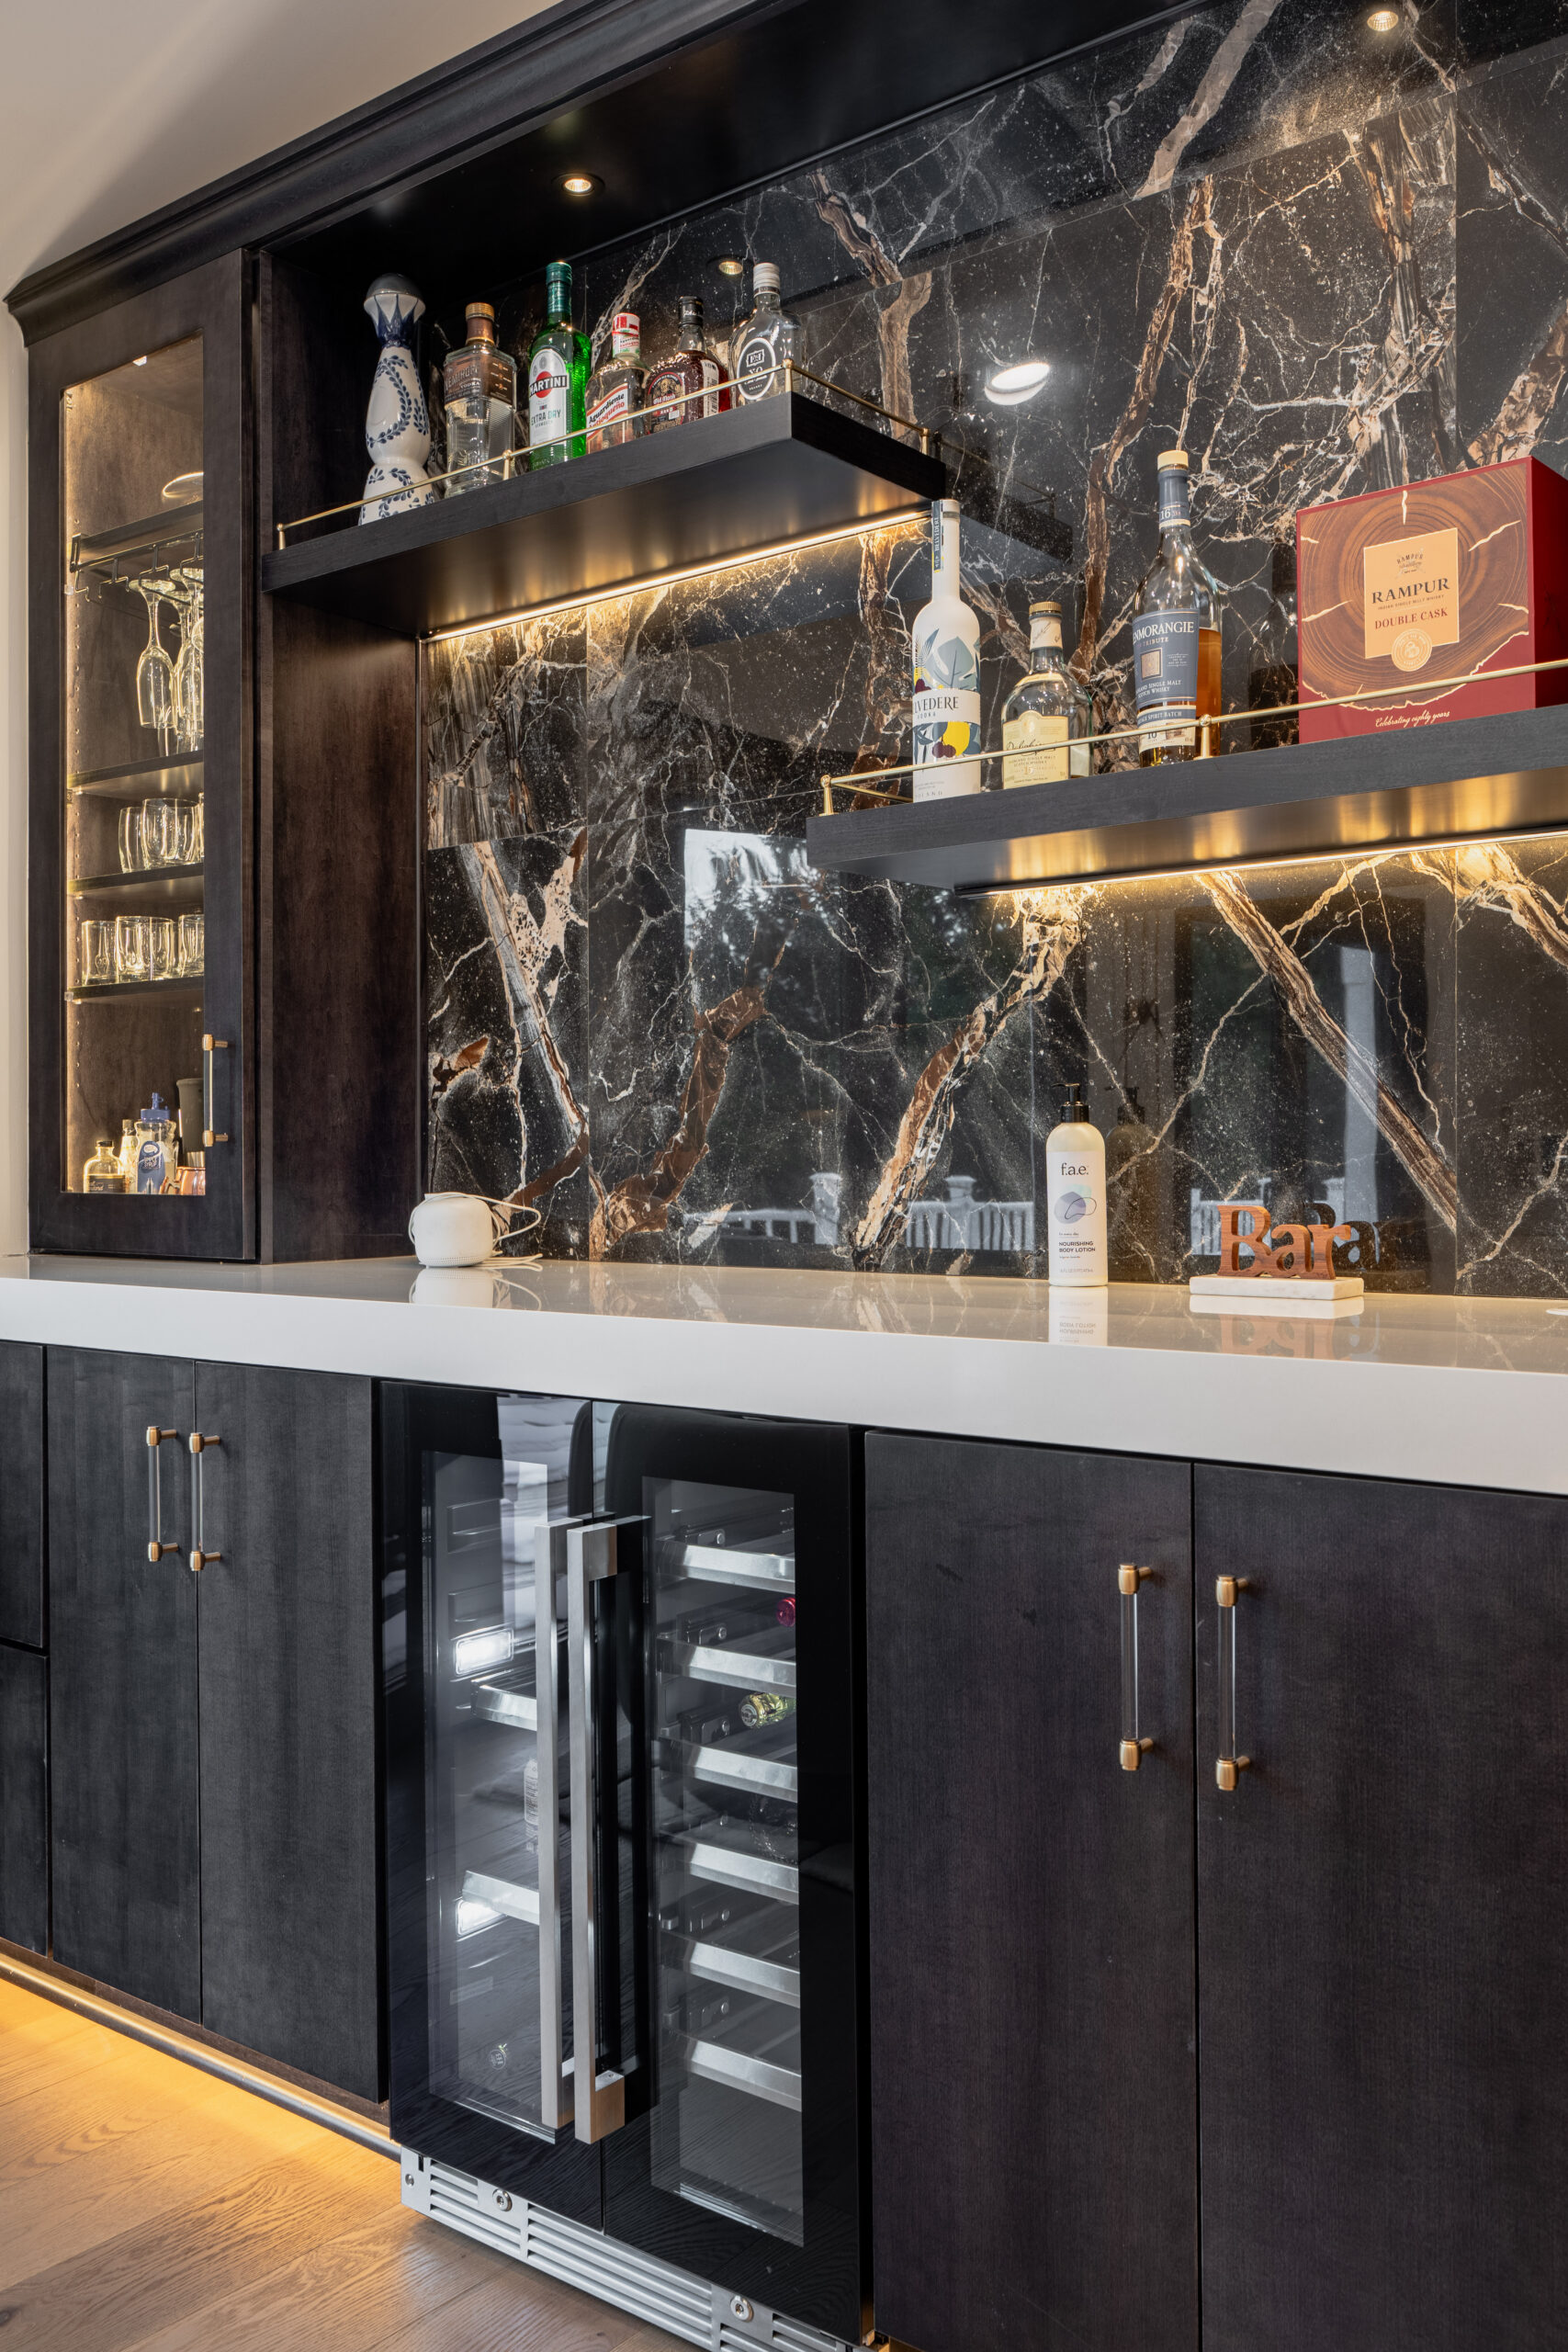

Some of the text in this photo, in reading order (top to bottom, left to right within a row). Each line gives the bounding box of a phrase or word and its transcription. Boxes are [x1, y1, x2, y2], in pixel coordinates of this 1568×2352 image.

[589, 392, 625, 423] Aguardiente
[531, 409, 561, 425] EXTRA DRY
[1160, 508, 1171, 520] 16
[1396, 553, 1424, 564] RAMPUR
[1371, 578, 1450, 604] RAMPUR
[1374, 606, 1449, 629] DOUBLE CASK
[1132, 621, 1195, 645] ENMORANGIE
[1142, 636, 1169, 647] TRIBUTE
[1148, 681, 1166, 689] SINGLE
[1151, 686, 1170, 695] WHISKY
[914, 695, 960, 714] LVEDERE
[1164, 710, 1182, 718] BATCH
[1375, 708, 1450, 729] Celebrating eighty years
[1061, 1162, 1089, 1176] f.a.e.
[1217, 1204, 1352, 1280] Bar
